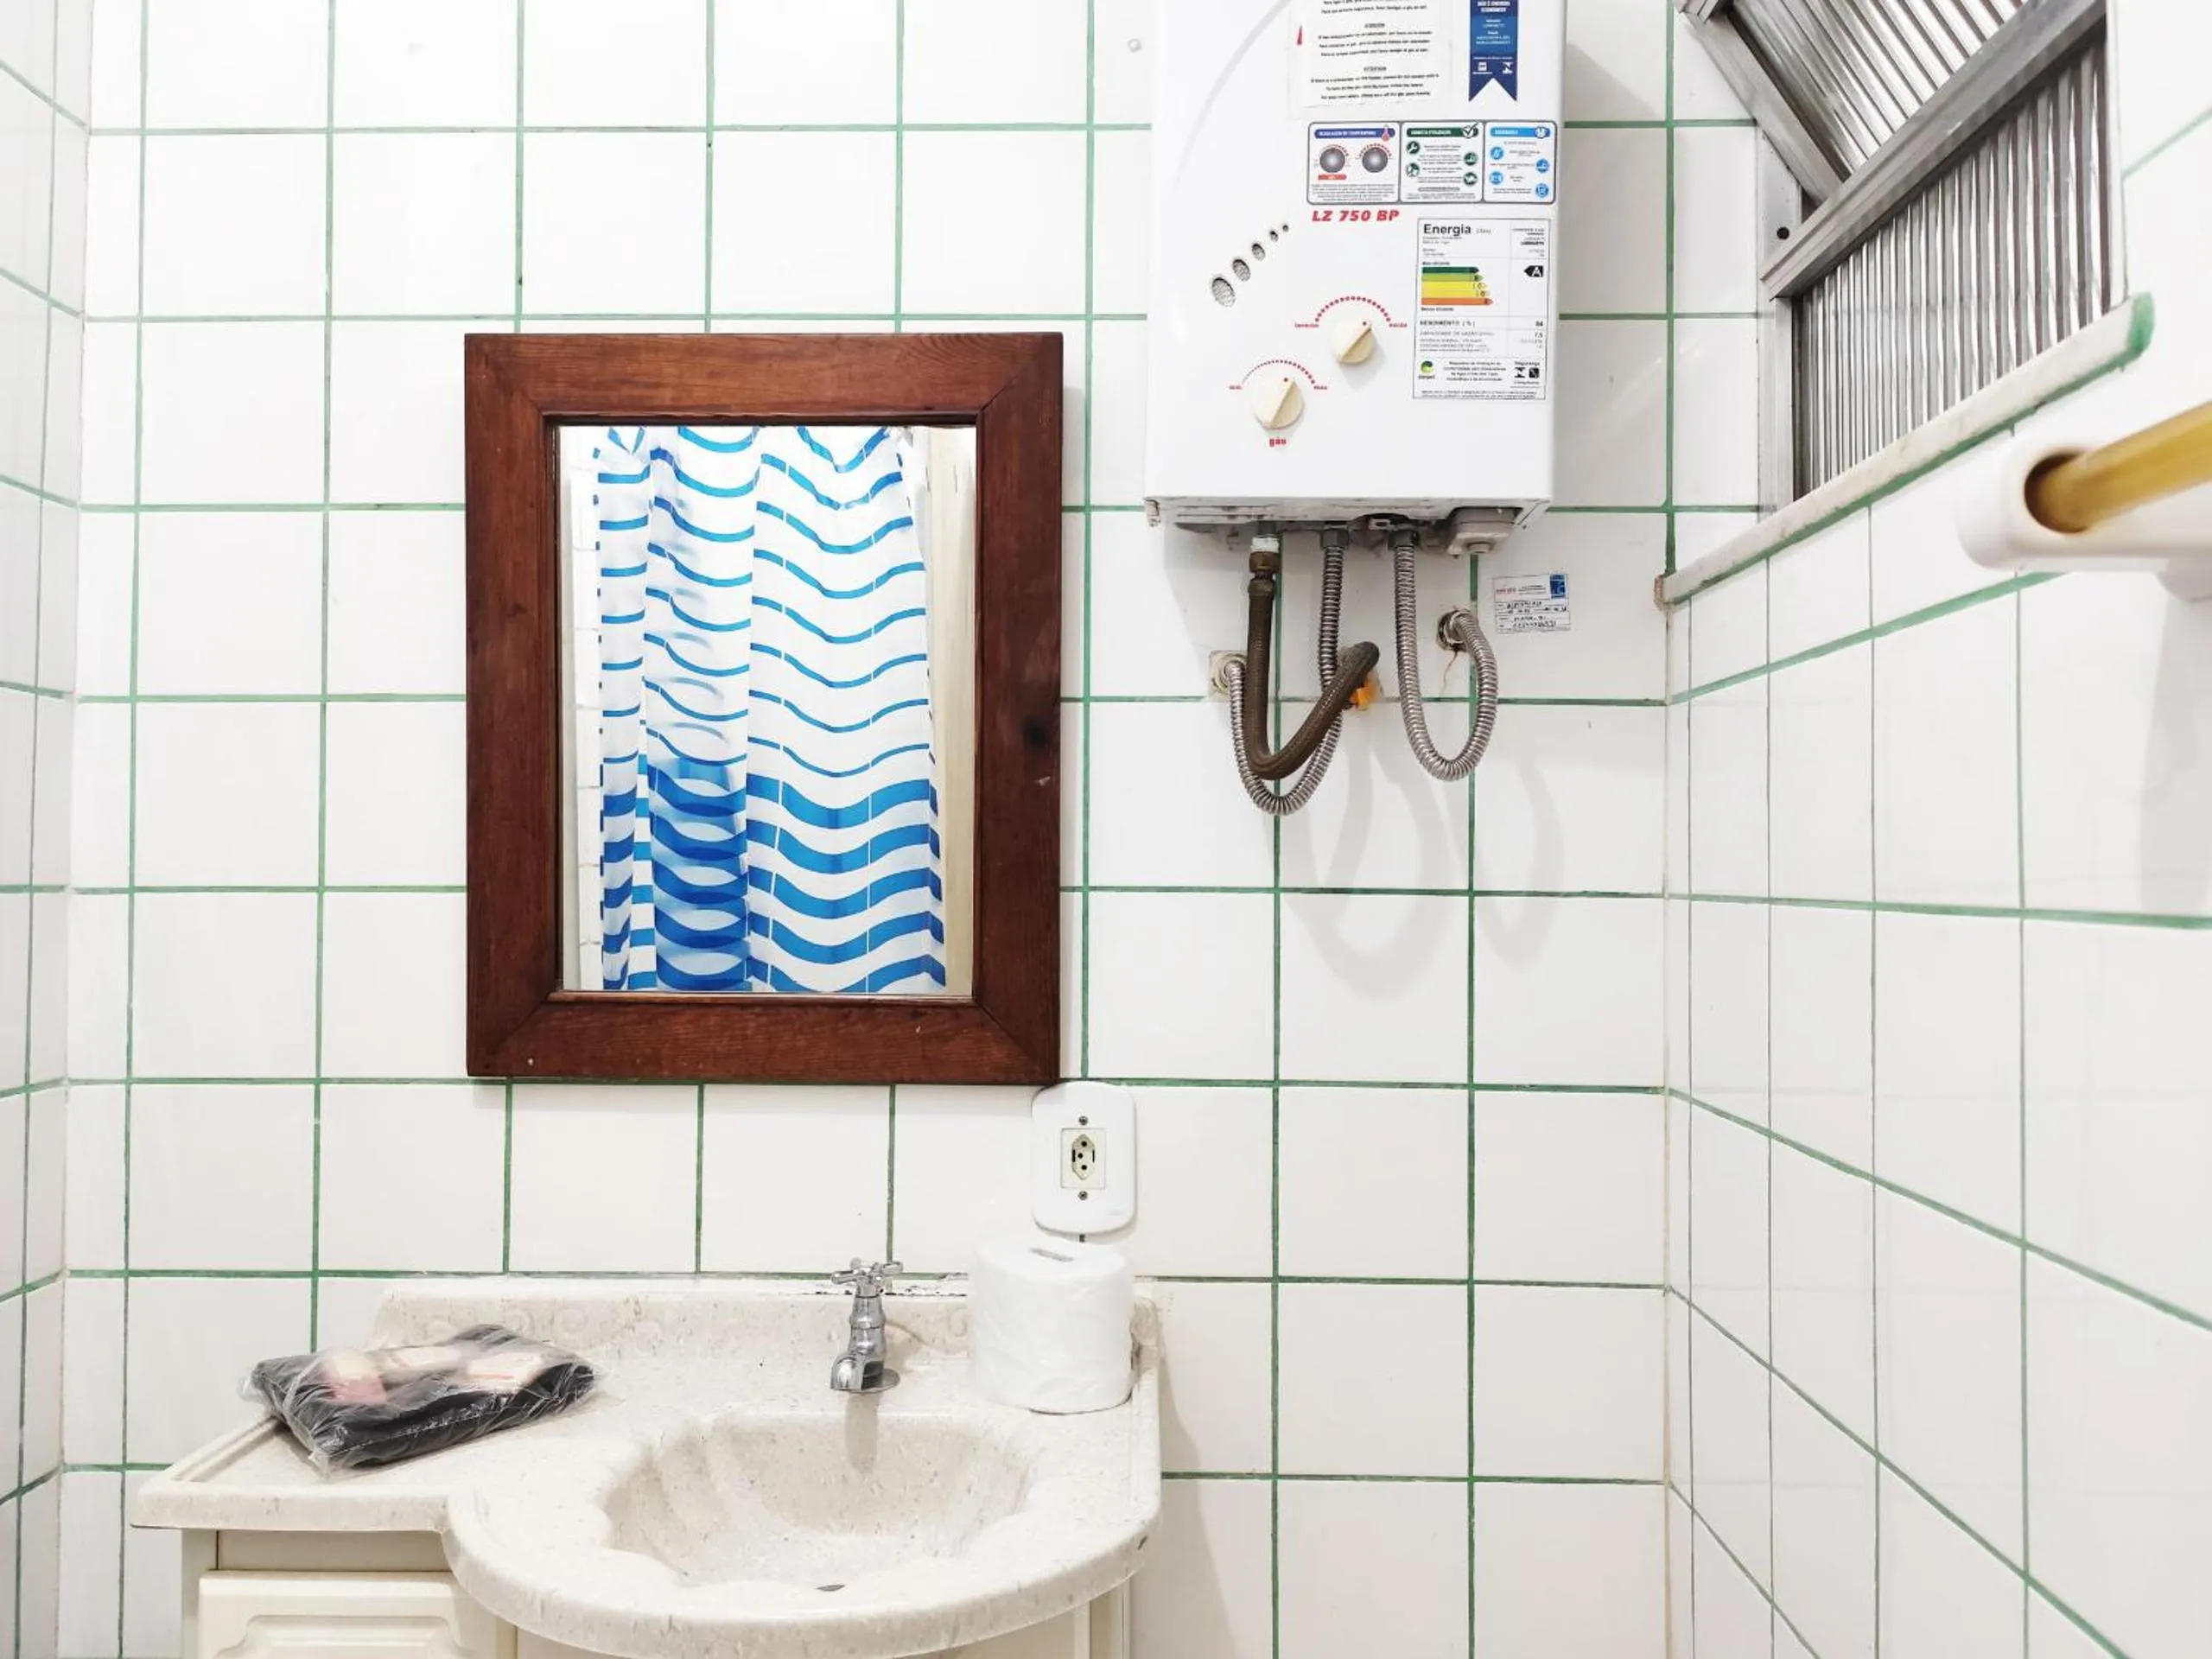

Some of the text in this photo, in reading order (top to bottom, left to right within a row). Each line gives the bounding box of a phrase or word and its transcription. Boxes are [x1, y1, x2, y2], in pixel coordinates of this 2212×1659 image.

[1312, 210, 1400, 222] LZ 750 BP
[1423, 223, 1471, 237] Energia
[1531, 266, 1542, 277] A
